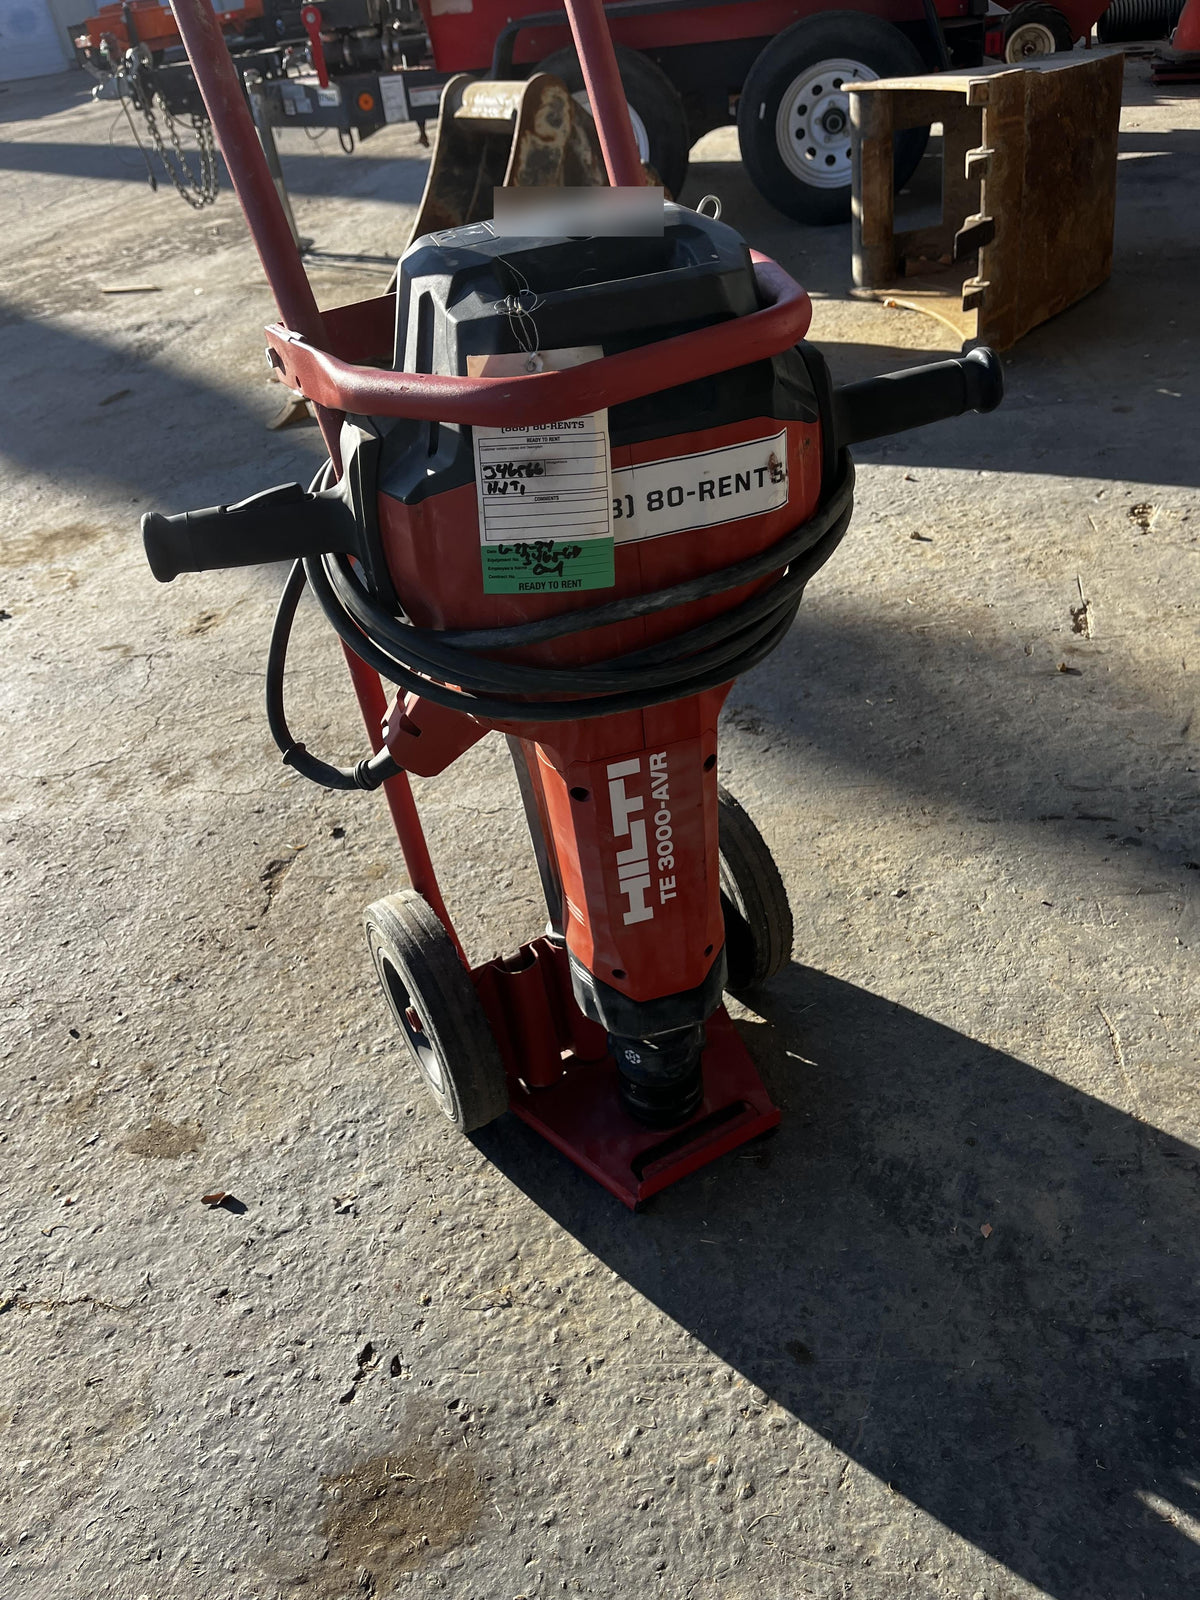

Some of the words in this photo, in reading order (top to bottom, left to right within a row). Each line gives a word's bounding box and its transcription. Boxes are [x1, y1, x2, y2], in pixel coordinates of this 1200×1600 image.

[646, 462, 783, 512] 80-RENTS
[518, 582, 546, 591] READY
[548, 581, 559, 590] TO
[561, 579, 582, 588] RENT
[650, 751, 675, 872] 3000-AVR
[607, 758, 654, 925] HILTI
[659, 875, 677, 904] TE
